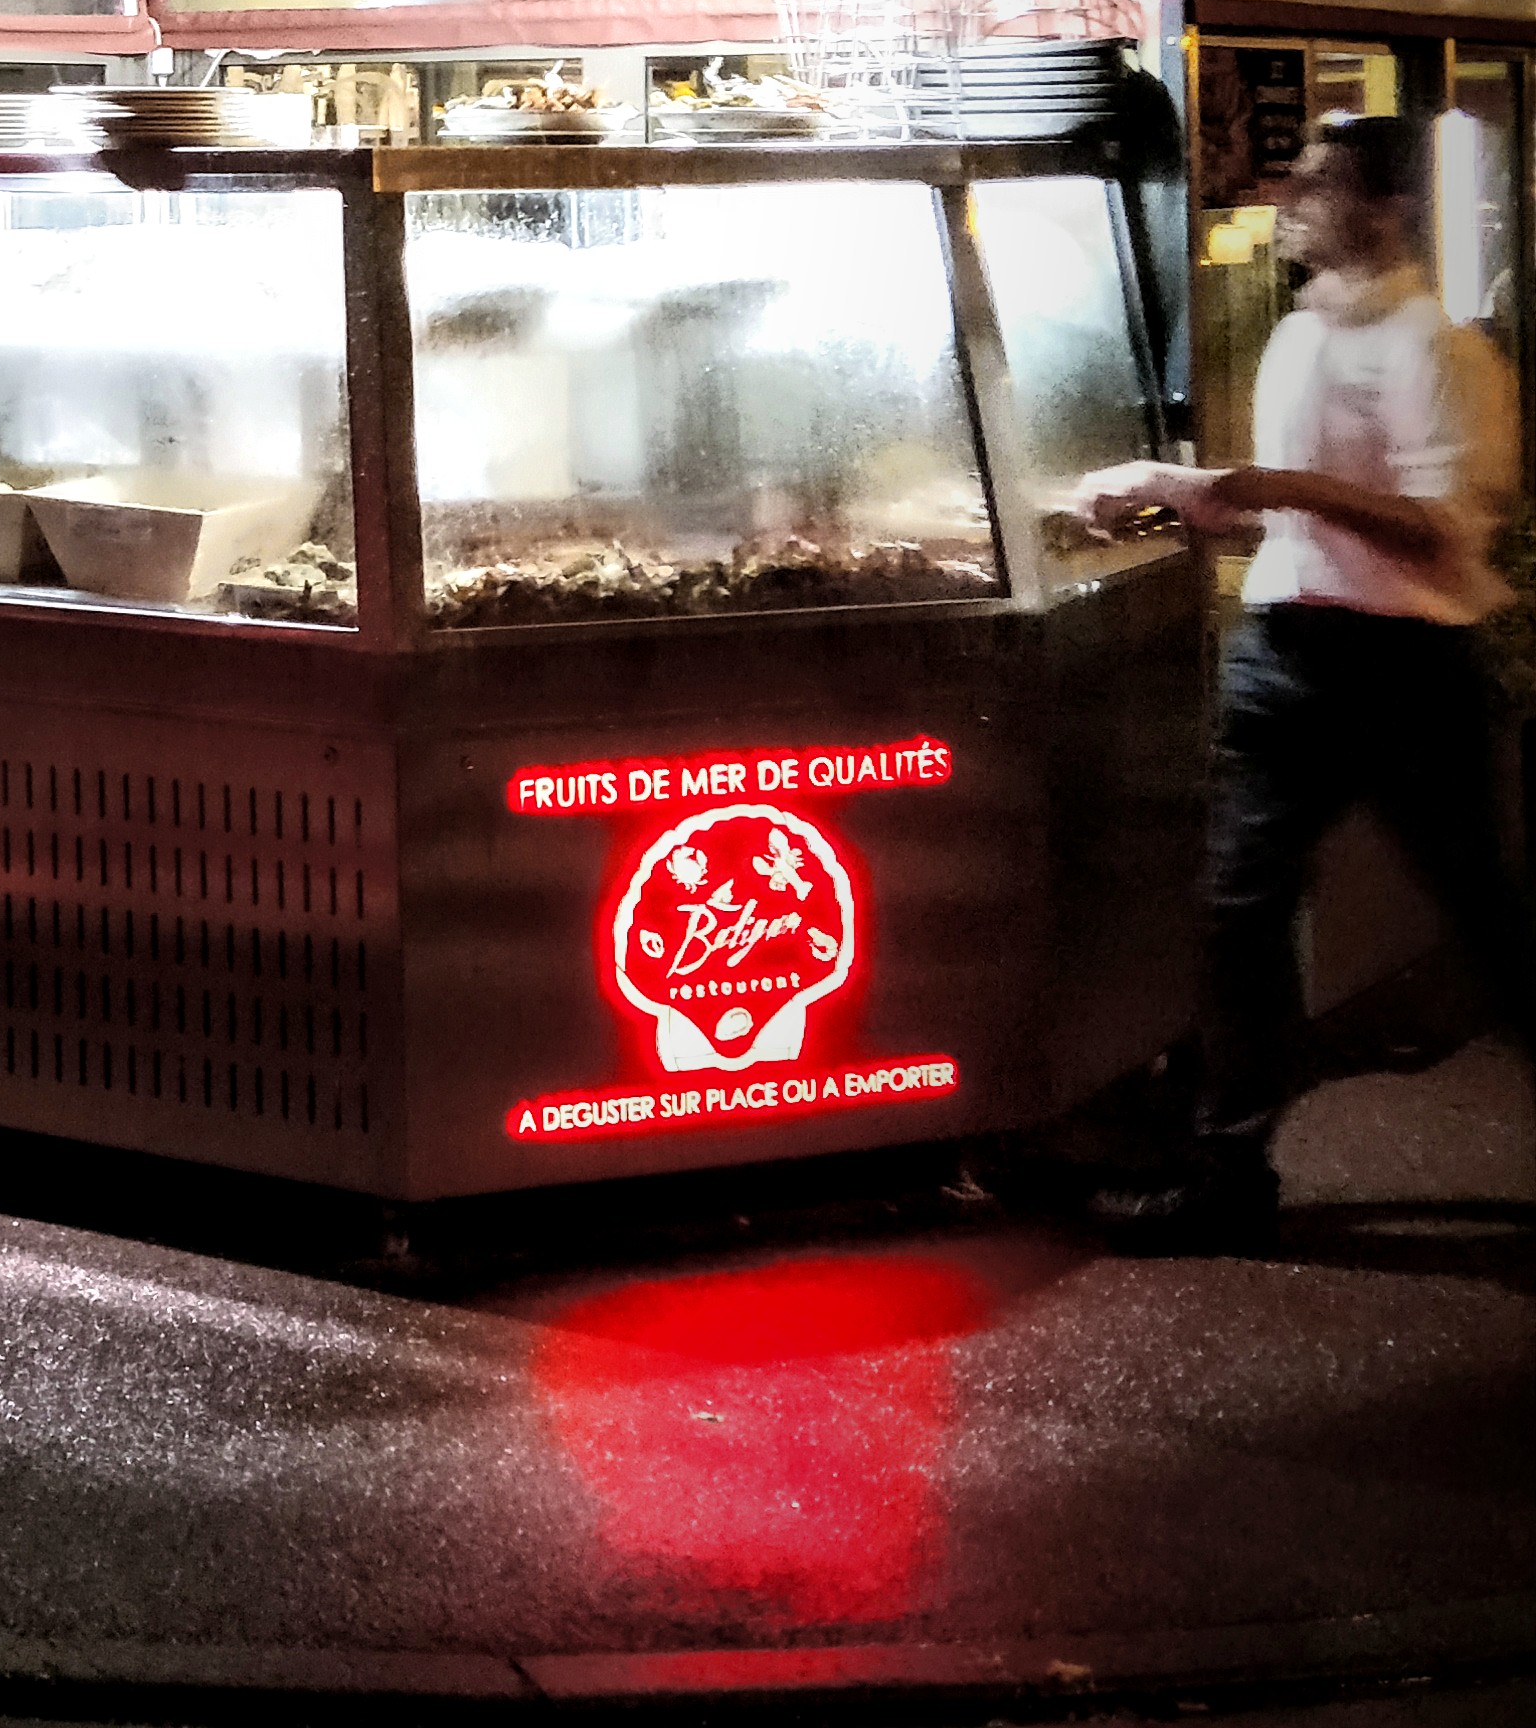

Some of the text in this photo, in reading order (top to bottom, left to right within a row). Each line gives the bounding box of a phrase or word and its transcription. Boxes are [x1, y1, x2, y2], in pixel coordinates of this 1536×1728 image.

[519, 741, 950, 810] FRUITS DE MER DE QUALITÉS
[518, 1062, 955, 1135] A DEGUSTER SUR PLACE OU A EMPORTER
